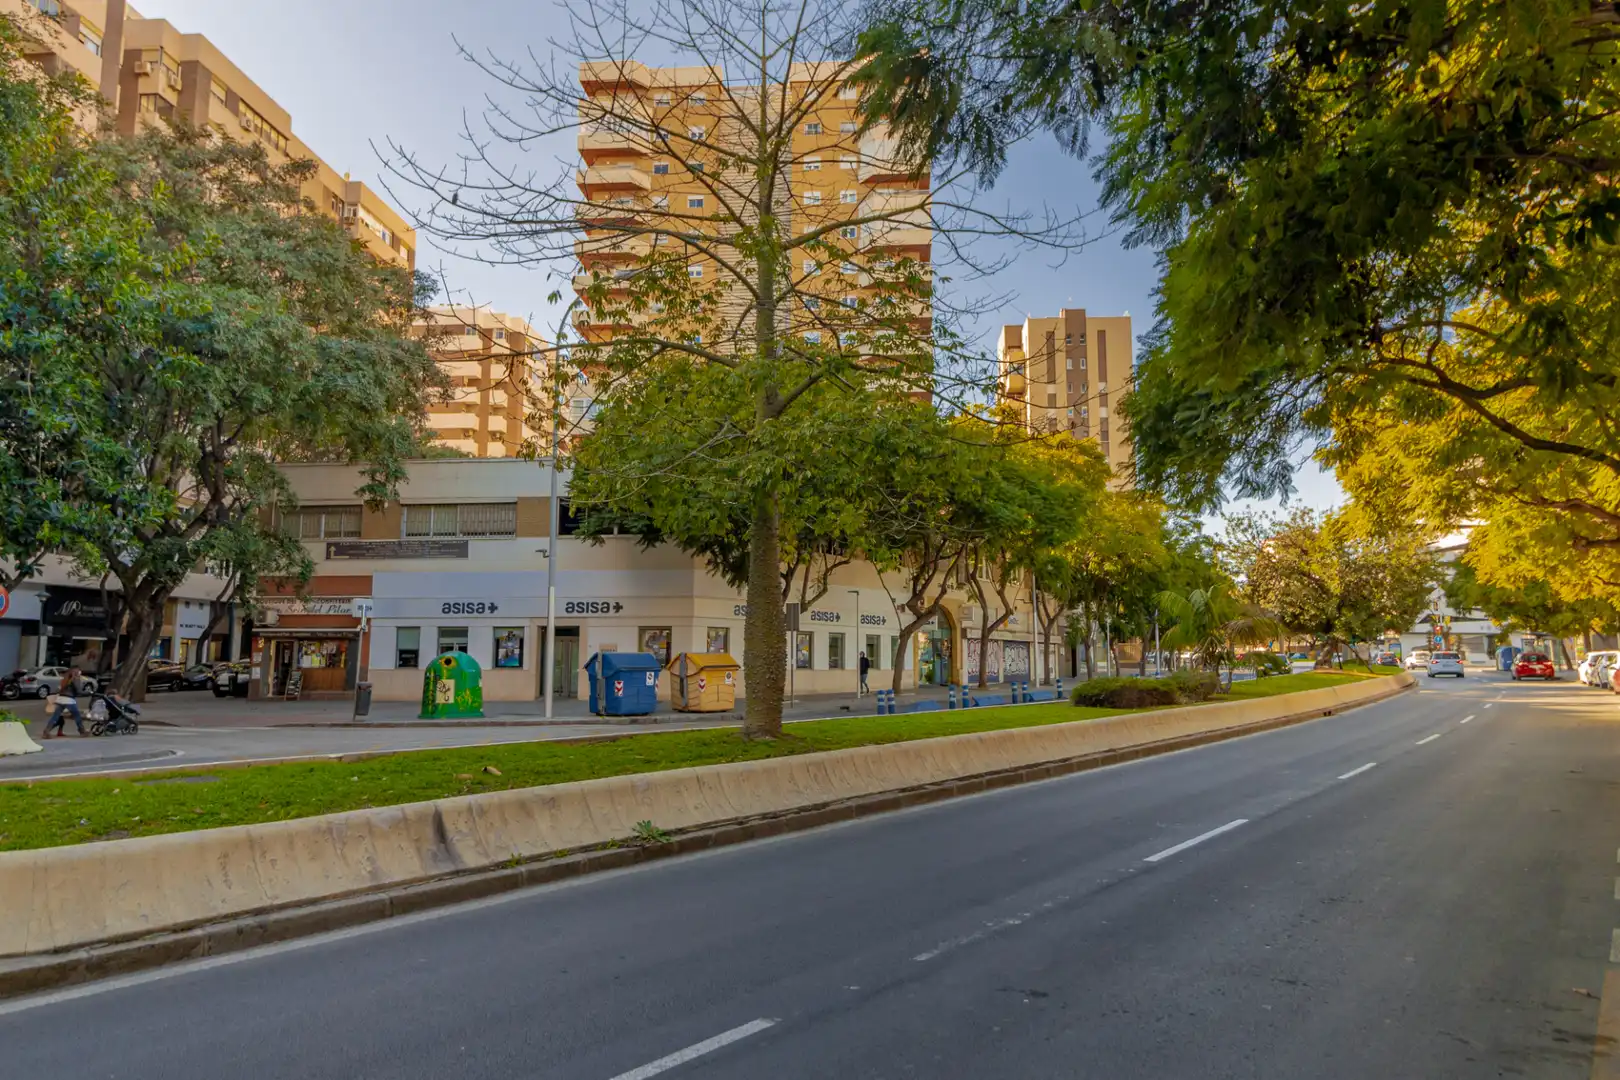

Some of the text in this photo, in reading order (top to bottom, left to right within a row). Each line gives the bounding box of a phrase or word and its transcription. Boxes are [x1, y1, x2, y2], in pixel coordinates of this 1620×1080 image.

[441, 601, 486, 614] asisa
[565, 601, 611, 614] asisa
[810, 609, 835, 622] asisa
[860, 613, 882, 625] asisa
